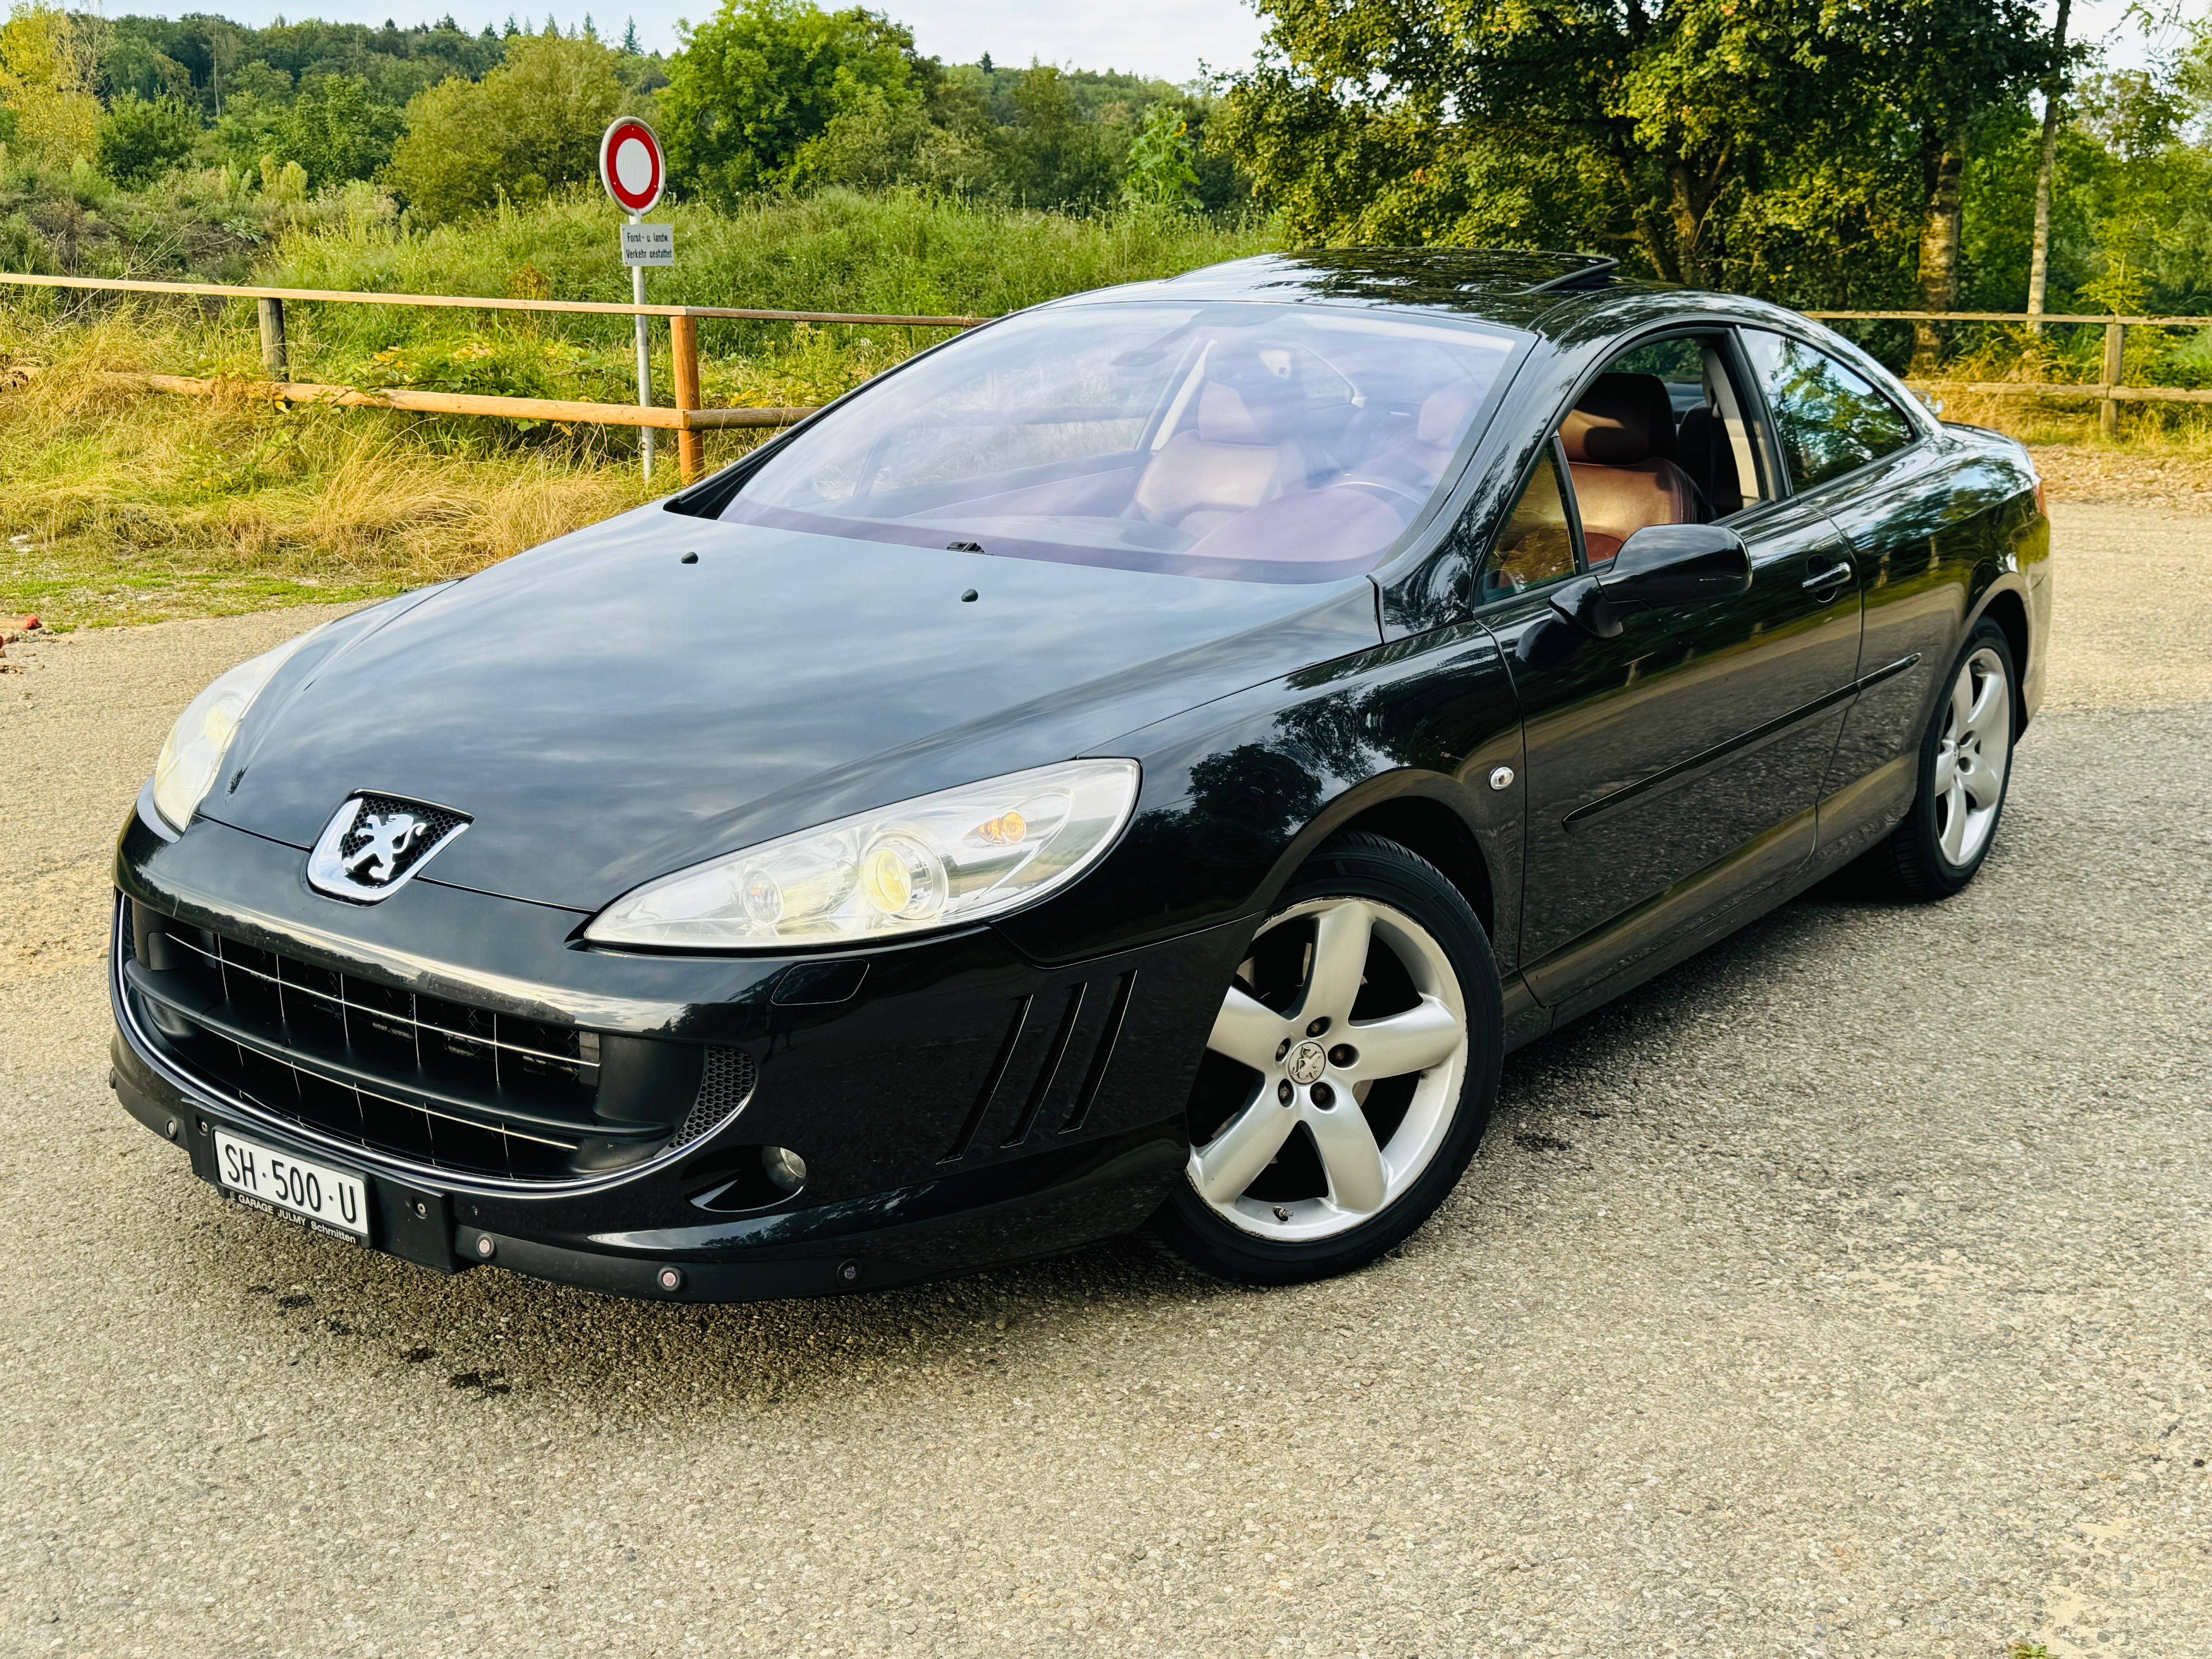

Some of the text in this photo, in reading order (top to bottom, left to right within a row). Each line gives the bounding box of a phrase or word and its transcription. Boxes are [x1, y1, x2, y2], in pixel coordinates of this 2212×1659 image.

[626, 249, 672, 259] Verkehr gestattet
[238, 1194, 356, 1244] GARAGE JULMY Schmitten
